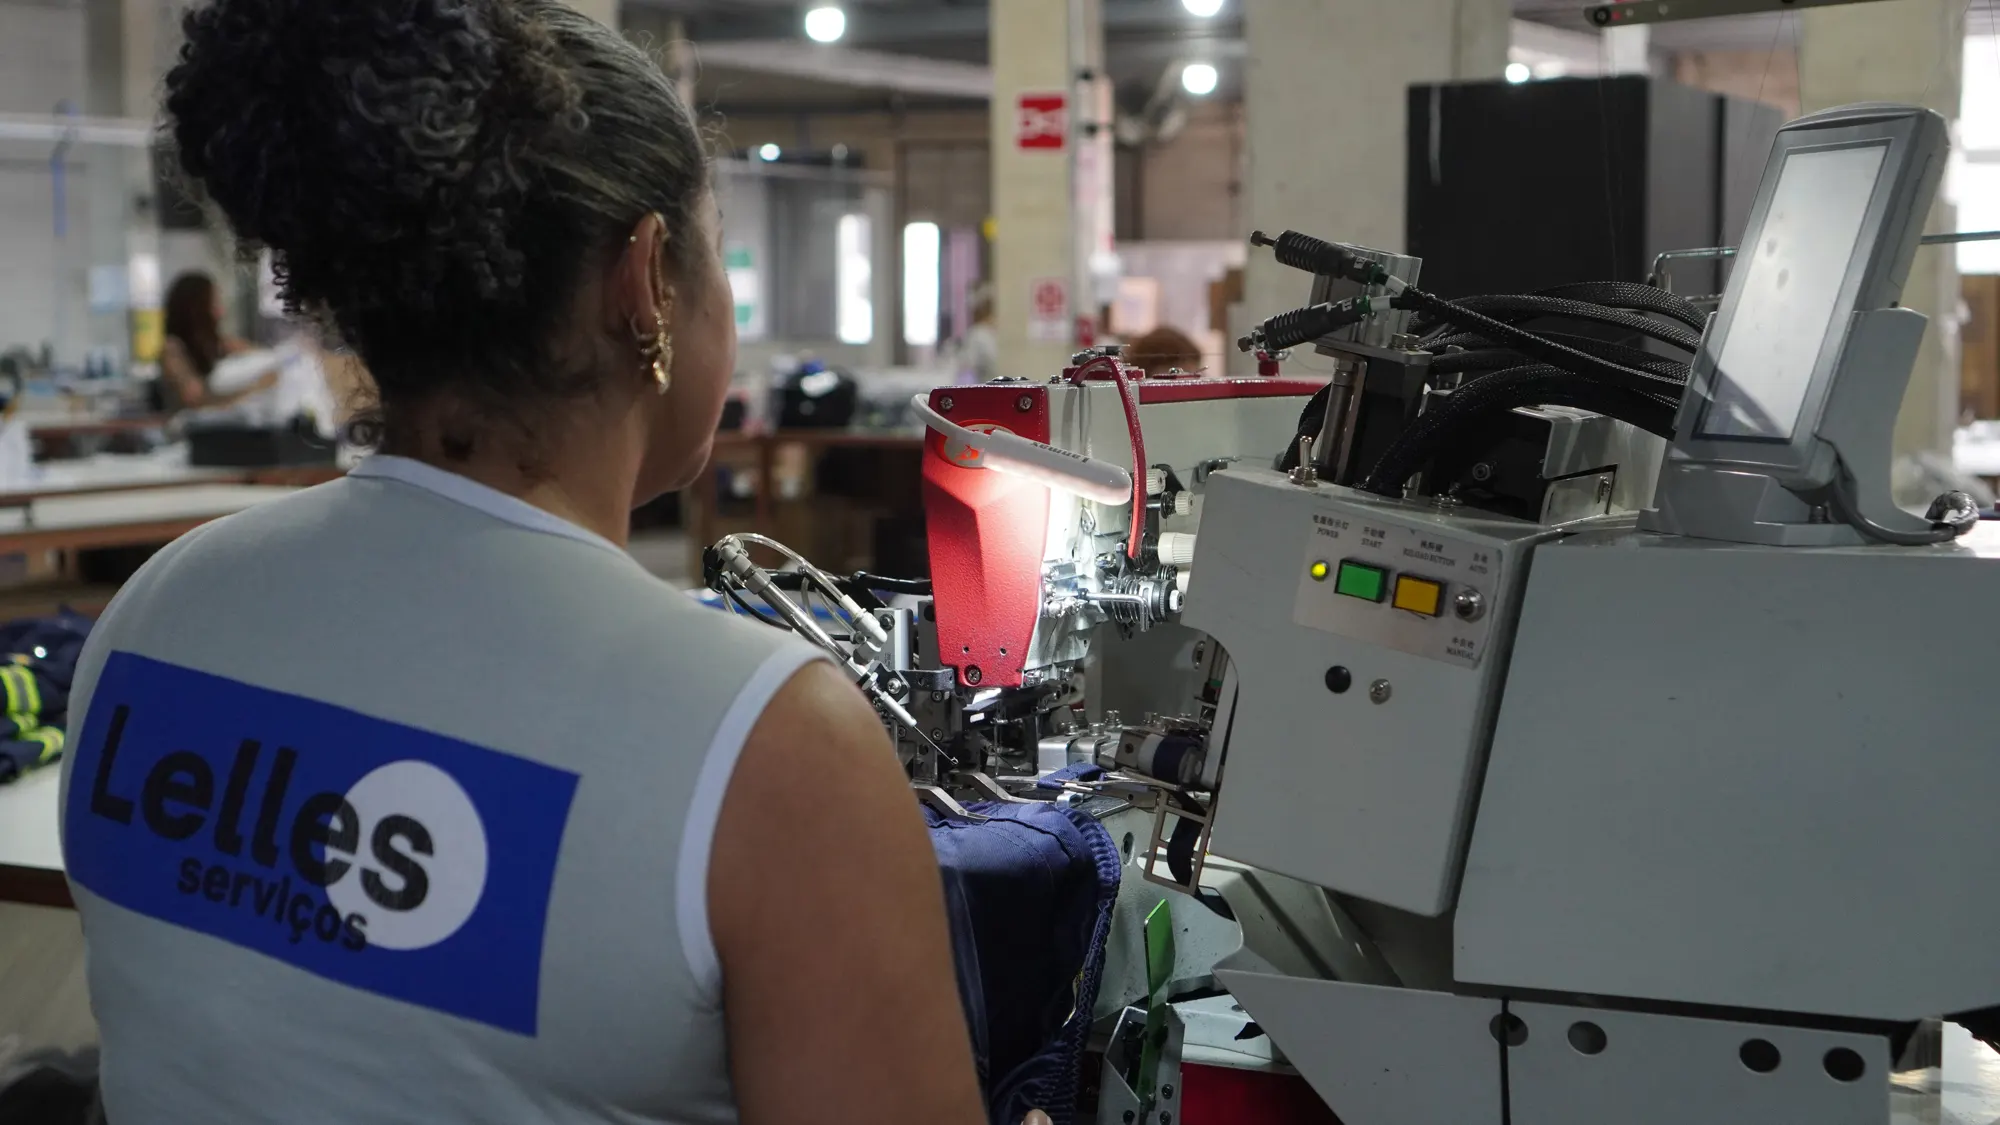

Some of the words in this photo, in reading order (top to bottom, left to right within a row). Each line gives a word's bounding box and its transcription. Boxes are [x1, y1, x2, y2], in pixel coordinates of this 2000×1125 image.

[1317, 527, 1339, 538] POWER
[1361, 538, 1383, 549] START
[91, 703, 434, 912] Lelles
[177, 857, 367, 952] serviços
